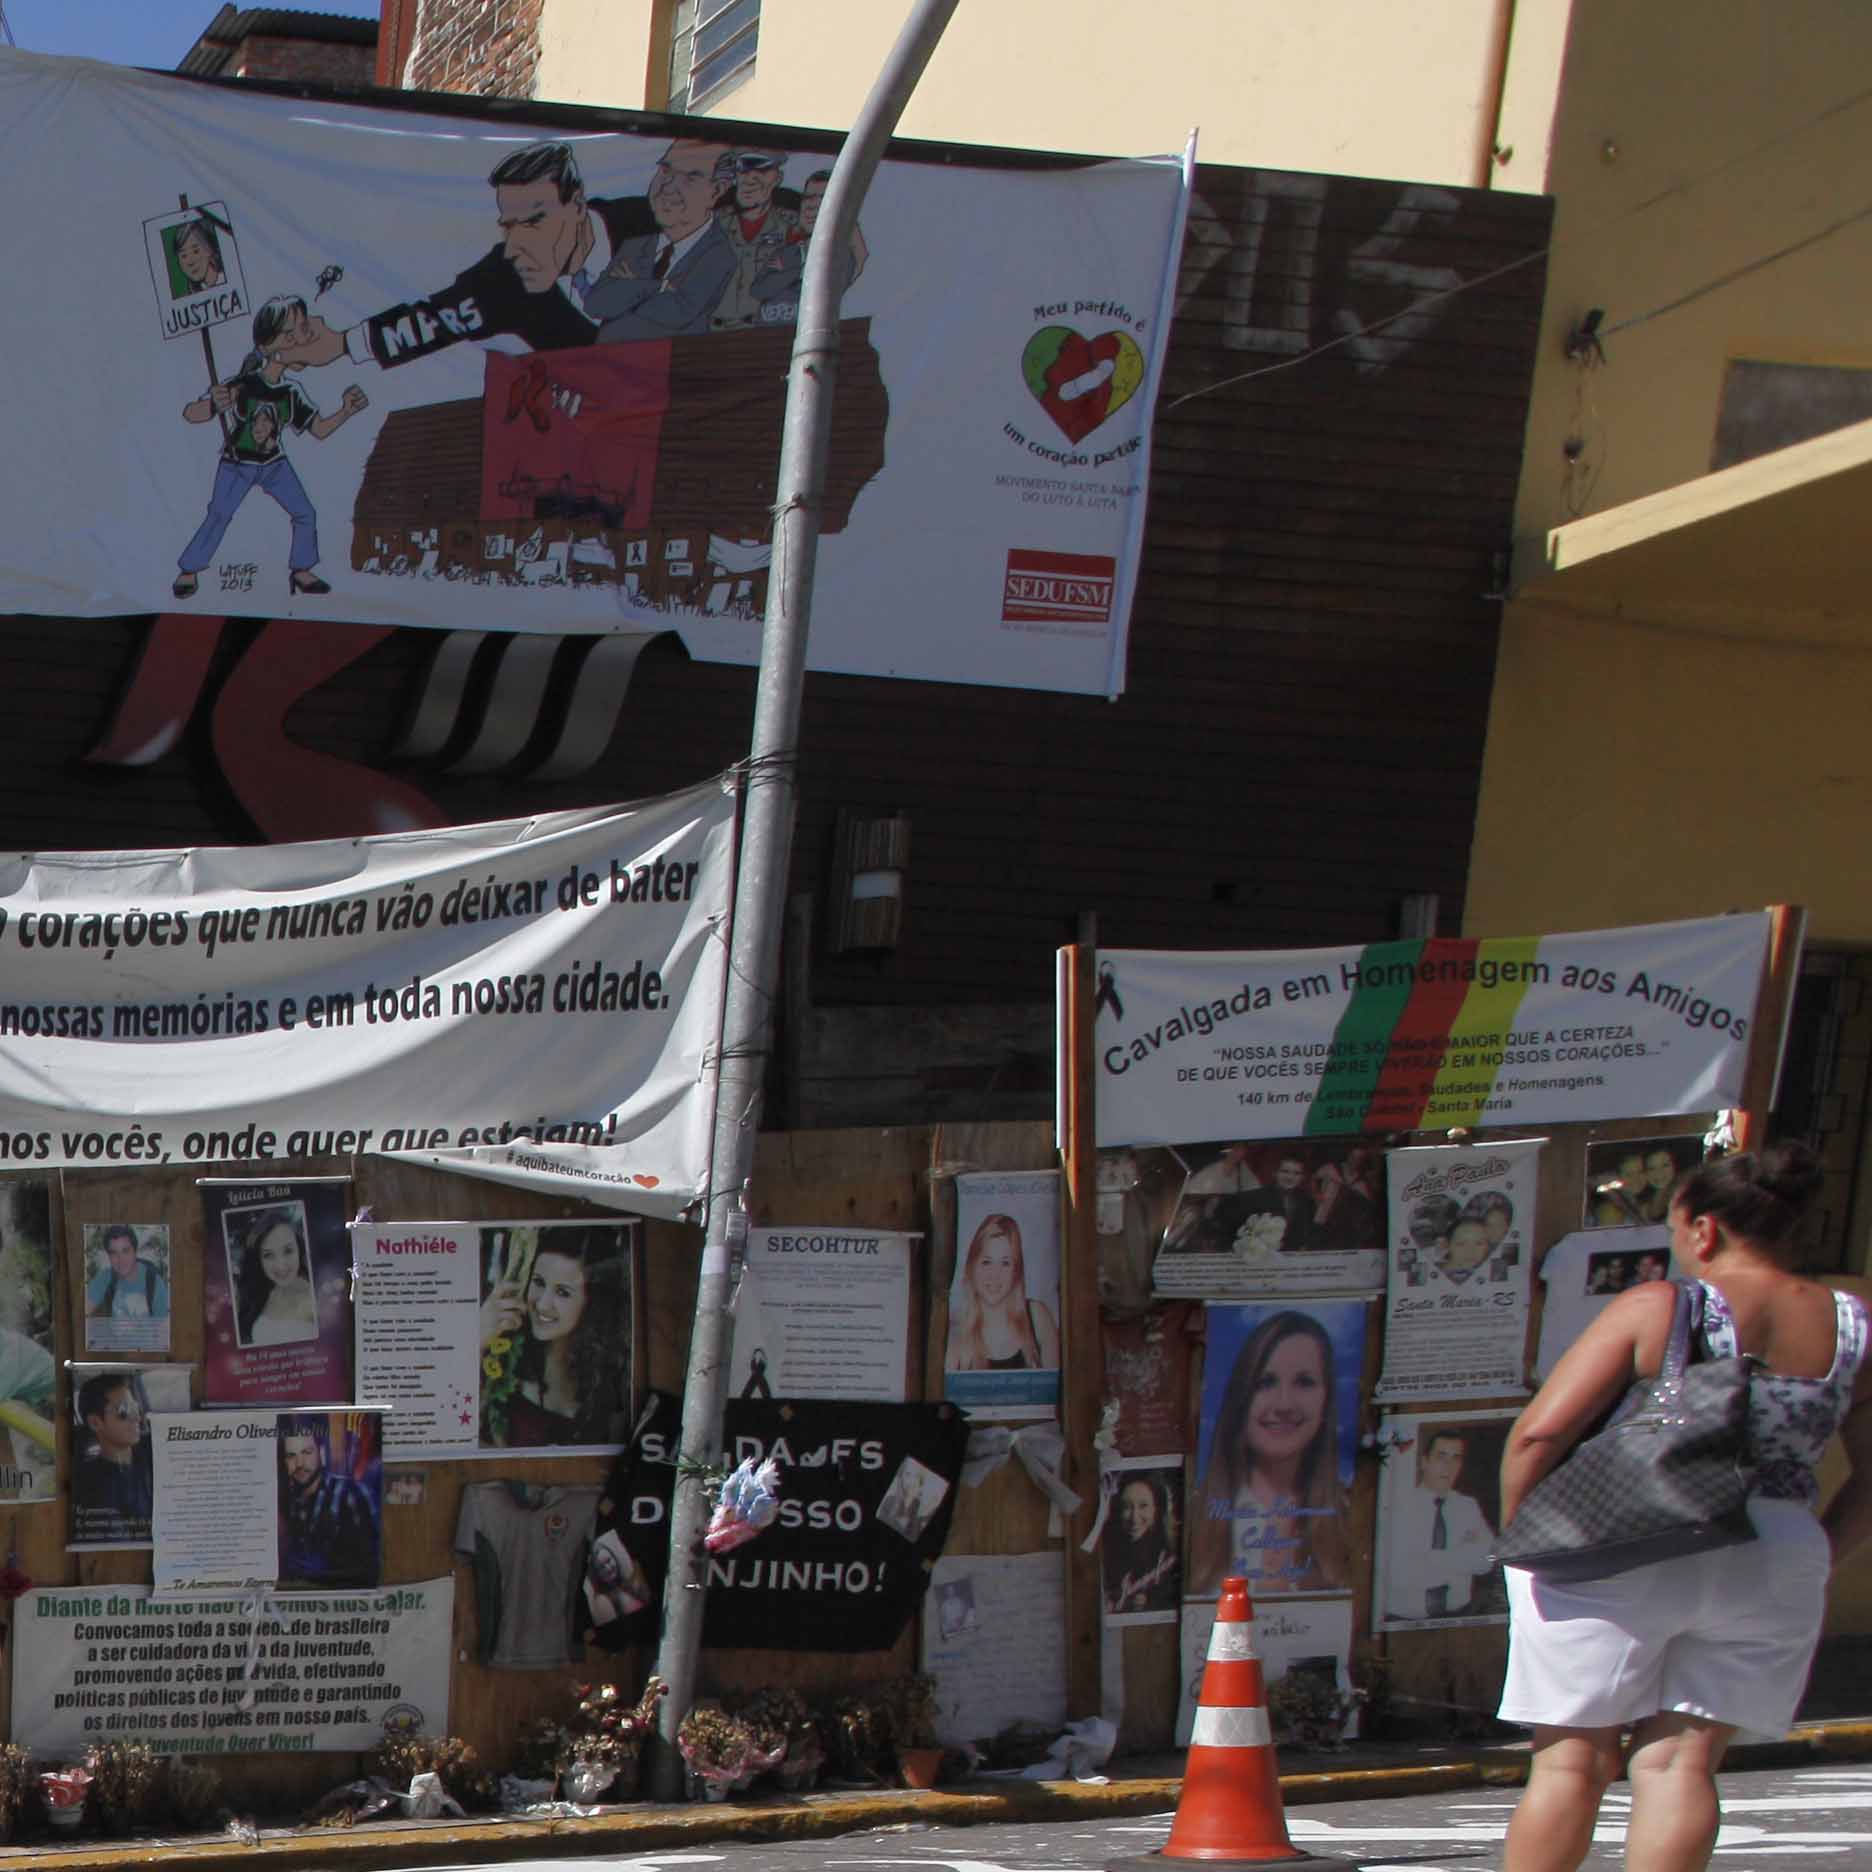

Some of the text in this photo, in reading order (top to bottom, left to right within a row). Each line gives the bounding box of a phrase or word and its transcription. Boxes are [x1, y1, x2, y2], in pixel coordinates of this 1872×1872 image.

[167, 290, 242, 333] JUSTIÇA
[1033, 300, 1132, 324] Meu partido
[1002, 421, 1089, 468] um coração
[1006, 575, 1111, 607] SEDUFSM
[18, 907, 188, 960] corações
[199, 906, 259, 958] que
[266, 898, 367, 941] nunca
[376, 884, 433, 932] vão
[440, 876, 548, 925] deixar
[557, 866, 600, 911] de
[610, 856, 698, 904] bater
[0, 1003, 103, 1038] nossas
[113, 993, 269, 1038] memórias
[305, 994, 354, 1029] em
[365, 976, 441, 1024] toda
[451, 972, 546, 1015] nossa
[553, 960, 670, 1012] cidade.
[1105, 957, 1750, 1075] Cavalgada em Homenagem aos Amigos
[1281, 1025, 1633, 1058] SAUDADE QUE CERTEZA
[1177, 1068, 1198, 1082] DE
[1203, 1066, 1237, 1081] QUE
[1304, 1057, 1369, 1075] SEMPRE
[1452, 1055, 1475, 1068] EM
[1480, 1049, 1550, 1066] NOSSOS
[1238, 1074, 1603, 1106] 140 km de Homenagens
[1428, 1098, 1512, 1114] Santa Maria
[62, 1125, 173, 1165] vocês,
[183, 1123, 277, 1160] onde
[286, 1127, 372, 1158] quer
[381, 1130, 448, 1153] que
[376, 1236, 458, 1256] Nathiéle
[767, 1236, 879, 1256] SECOHTUR
[167, 1425, 232, 1442] Elisandro
[706, 1559, 887, 1594] NJINHO!
[36, 1590, 427, 1617] Diante da calar.
[74, 1617, 390, 1641] Convocamos toda brasileira
[101, 1639, 375, 1662] ser cuidadora da da juventude,
[74, 1666, 172, 1686] promovendo
[176, 1664, 223, 1684] ações
[303, 1661, 385, 1680] efetivando
[129, 1688, 196, 1708] públicas
[199, 1687, 218, 1705] de
[316, 1684, 401, 1703] garantindo
[84, 1716, 103, 1731] os
[106, 1712, 167, 1730] direitos
[171, 1712, 203, 1728] dos
[203, 1711, 253, 1729] jovens
[256, 1711, 280, 1726] em
[283, 1710, 331, 1726] nosso
